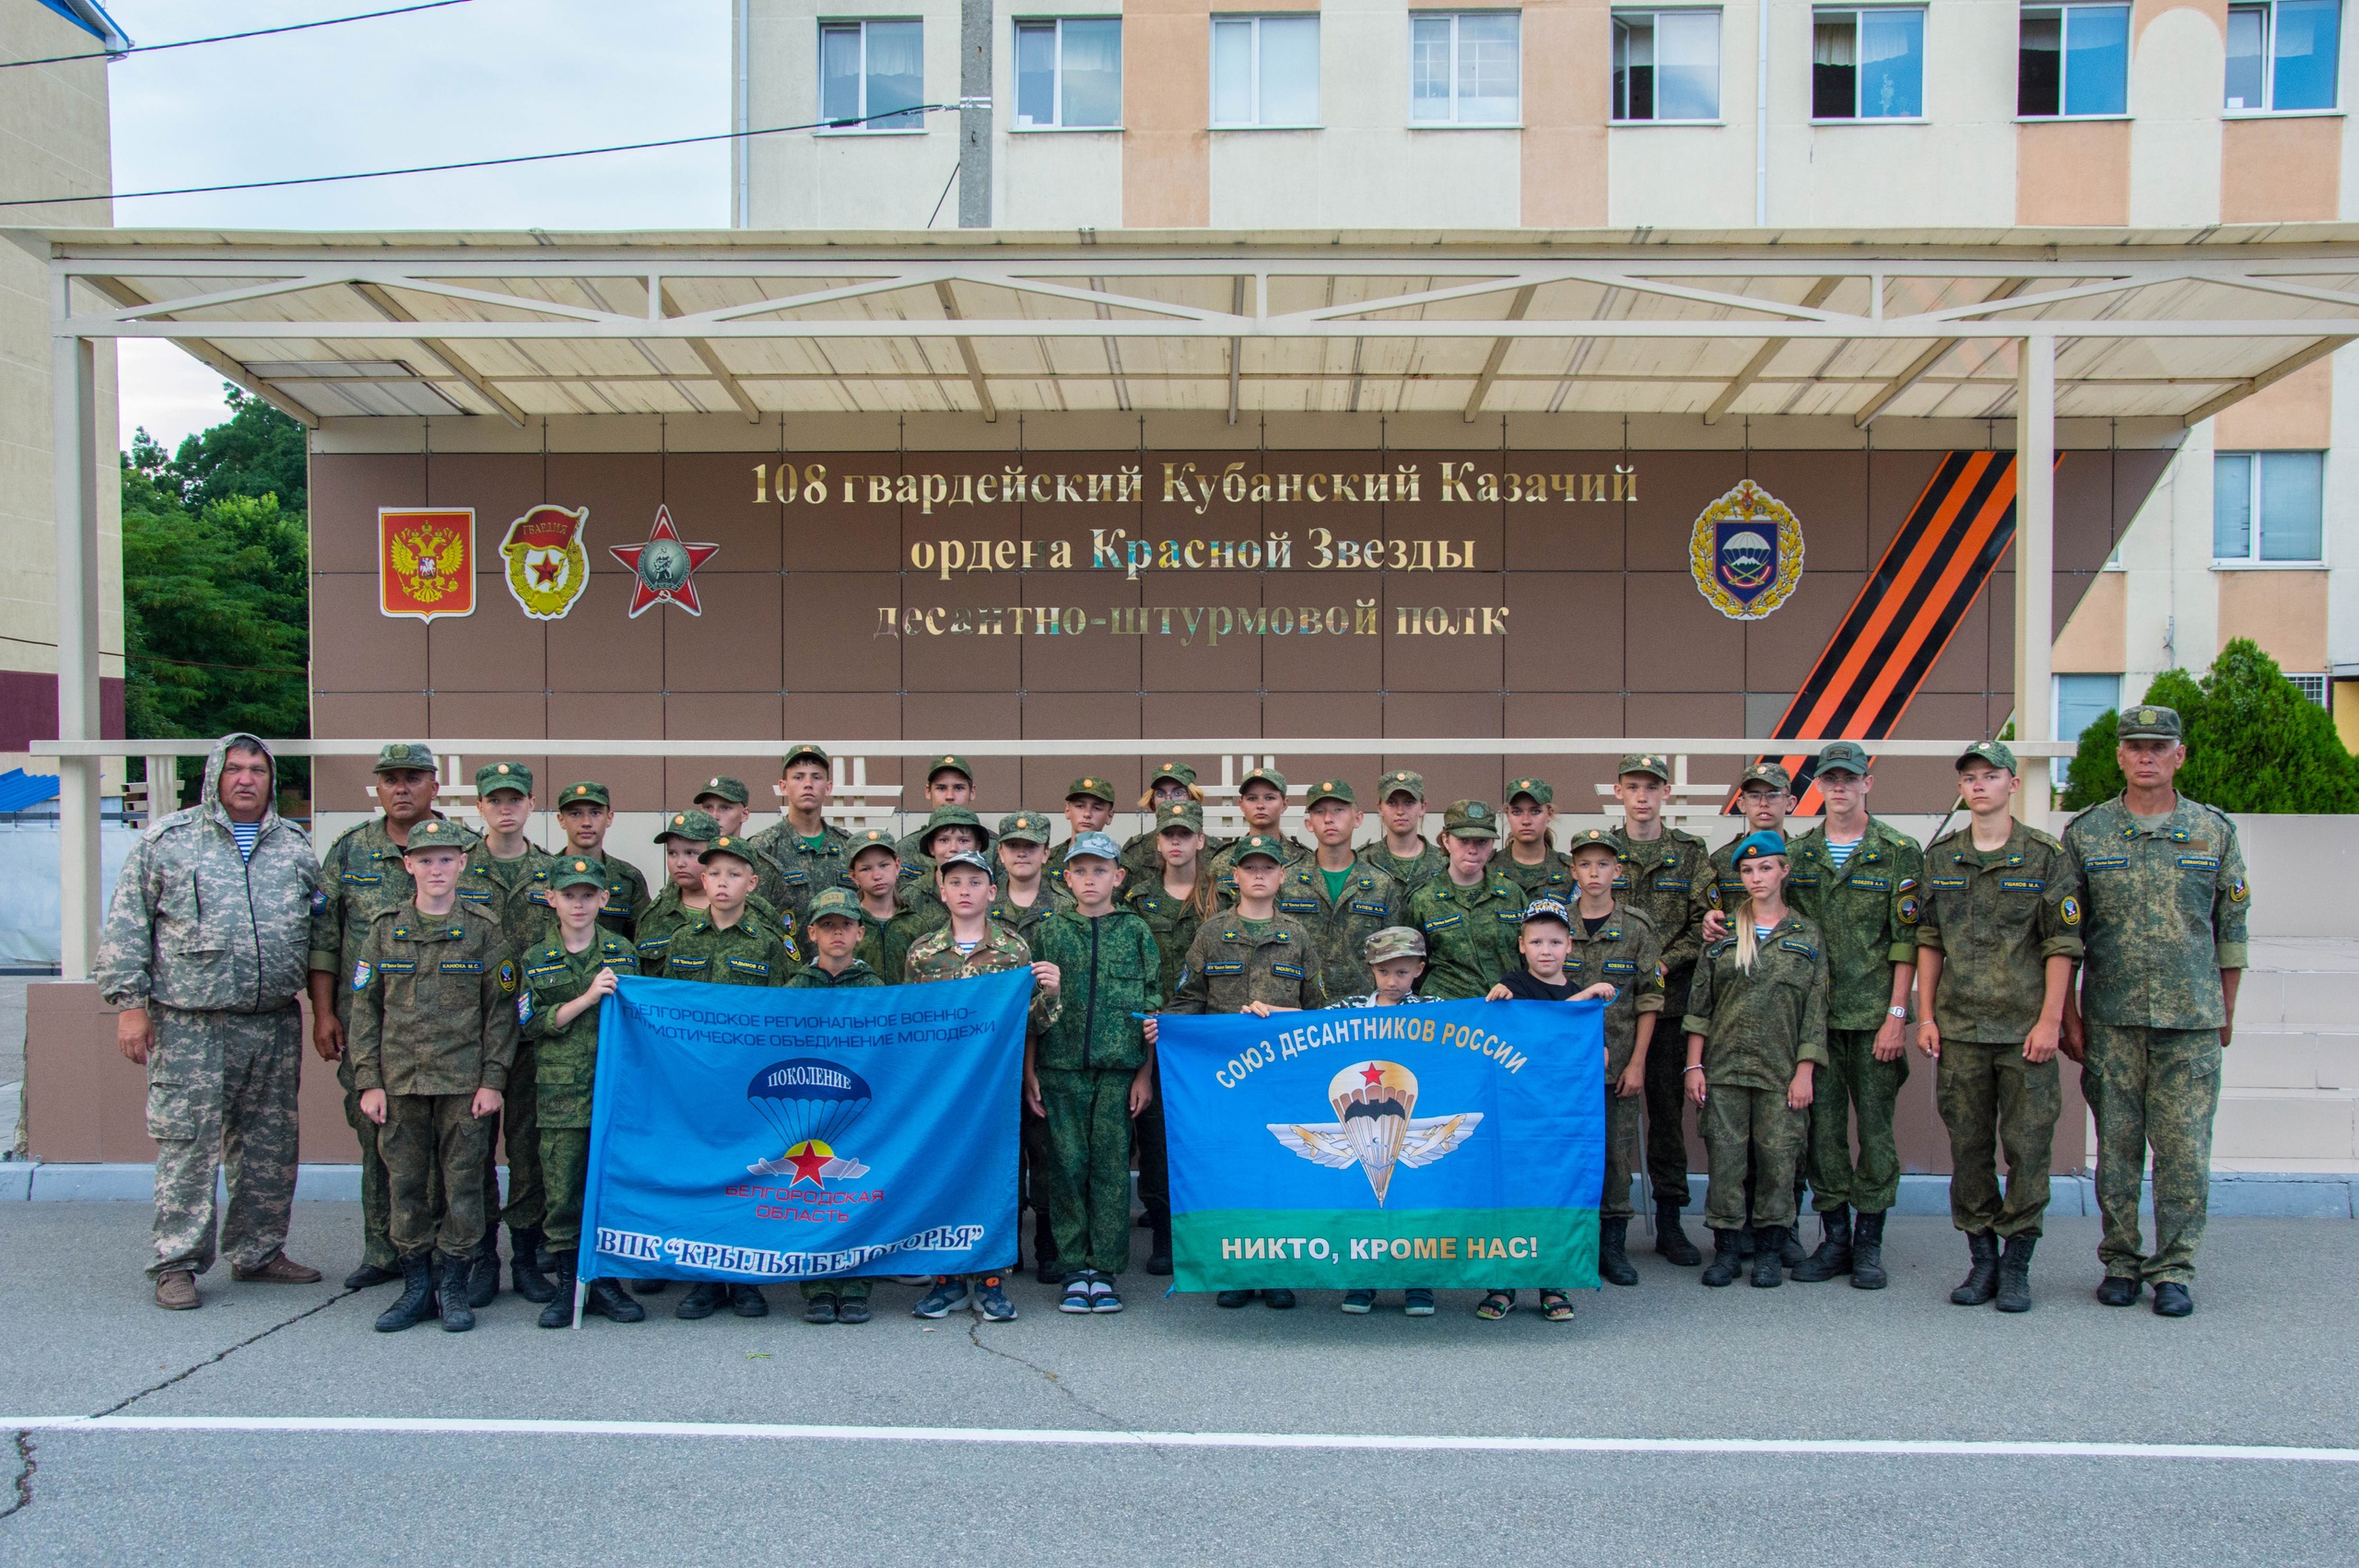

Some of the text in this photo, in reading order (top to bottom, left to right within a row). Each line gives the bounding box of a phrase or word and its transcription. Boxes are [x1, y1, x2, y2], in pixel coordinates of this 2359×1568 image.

[751, 462, 1637, 514] 108 гвардейский Кубанский Казачий
[522, 521, 568, 534] ГВАРДИЯ
[910, 528, 1475, 580] ордена Красной Звезды
[874, 598, 1509, 647] десантно-штурмовой полк
[764, 1013, 898, 1029] РЕГИОНАЛЬНОЕ
[900, 1008, 978, 1025] ВОЕННО-
[769, 1033, 894, 1048] ОБЪЕДИНЕНИЕ
[898, 1021, 996, 1044] МОЛОДЕЖИ
[1215, 1017, 1528, 1089] СОЮЗ ДЕСАНТНИКОВ РОССИИ
[768, 1066, 851, 1090] ПОКОЛЕНИЕ
[725, 1185, 884, 1206] БЕЛГОРОДСКАЯ
[756, 1204, 850, 1223] ОБЛАСТЬ
[597, 1228, 662, 1260] ВПК
[1221, 1236, 1539, 1265] НИКТО, КРОМЕ НАС!
